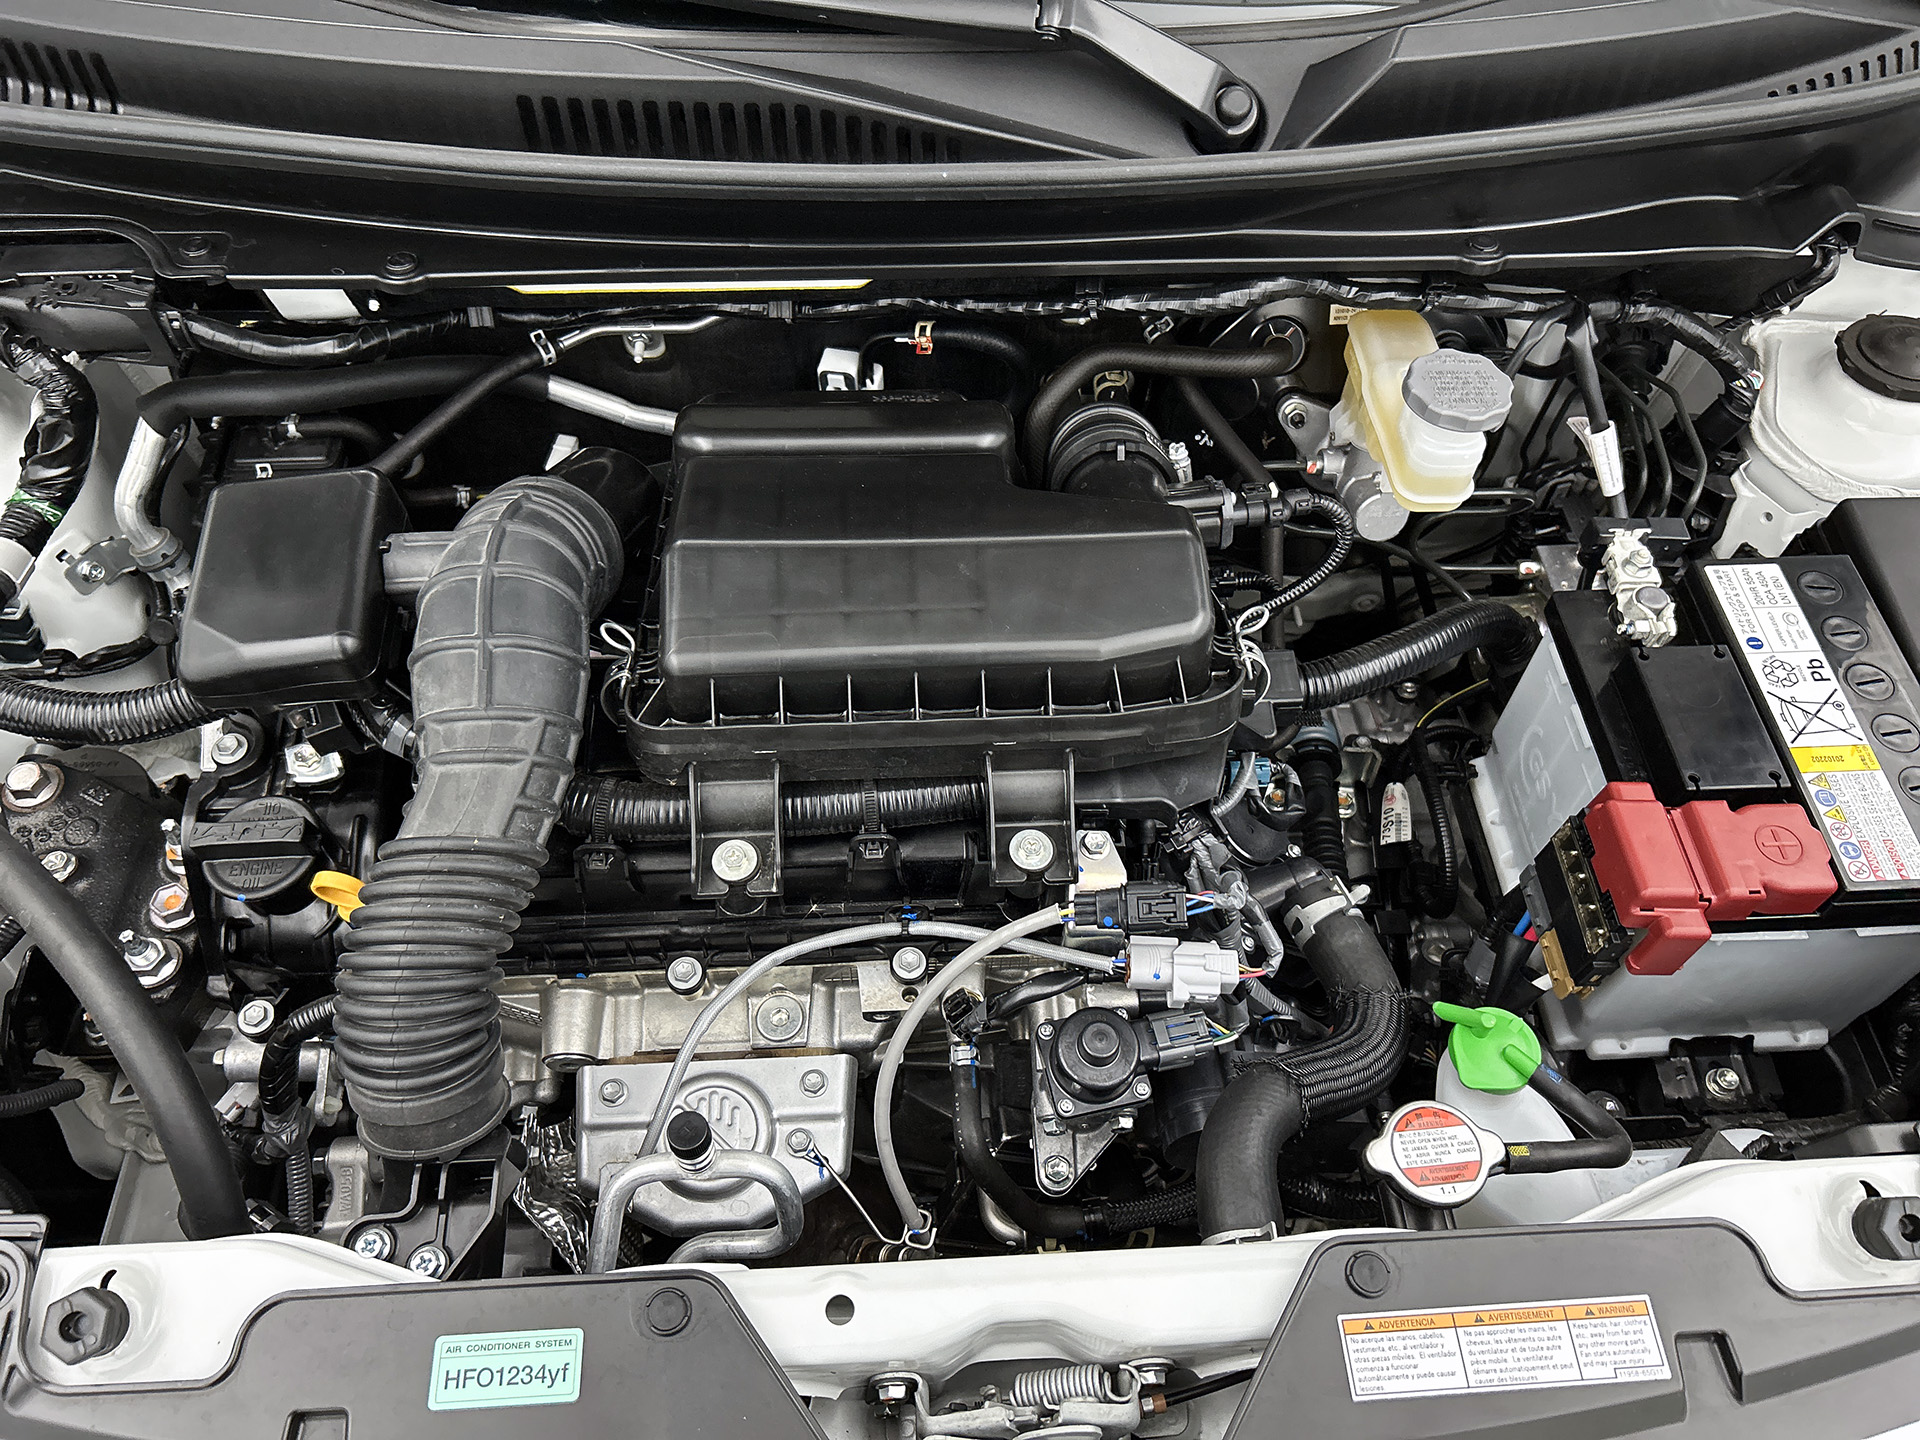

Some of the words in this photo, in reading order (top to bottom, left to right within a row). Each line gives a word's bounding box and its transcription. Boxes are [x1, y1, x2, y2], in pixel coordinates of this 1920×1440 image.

[1722, 569, 1737, 590] START
[1740, 567, 1755, 584] 55Ah
[1770, 575, 1784, 590] (EN)
[1749, 586, 1765, 605] 20HR
[1736, 598, 1750, 616] STOP
[1745, 618, 1757, 632] FOR
[1807, 659, 1831, 682] Pb
[1828, 773, 1846, 797] GASES
[1840, 799, 1866, 838] EXPLOSIVE
[1860, 840, 1881, 869] DANGER
[1884, 839, 1906, 868] POISON
[228, 861, 283, 877] ENGINE
[241, 877, 264, 889] OIL
[1440, 1186, 1457, 1194] 1.1
[1488, 1309, 1555, 1322] AVERTISSEMENT
[1597, 1304, 1635, 1315] WARNING
[1378, 1317, 1435, 1329] ADVERTENCIA
[1486, 1326, 1516, 1336] approcher
[1517, 1325, 1526, 1333] les
[1548, 1323, 1557, 1331] les
[1572, 1322, 1588, 1330] Keep
[1361, 1336, 1384, 1344] acerque
[1386, 1334, 1395, 1342] las
[1410, 1341, 1439, 1350] ventilador
[1504, 1335, 1535, 1344] vêtements
[445, 1345, 462, 1354] AIR
[466, 1341, 530, 1353] CONDITIONER
[535, 1338, 573, 1349] SYSTEM
[1468, 1348, 1476, 1356] du
[1528, 1344, 1544, 1352] toute
[1545, 1343, 1561, 1351] autre
[1427, 1350, 1457, 1358] ventilador
[1391, 1362, 1418, 1370] funcionar
[1583, 1359, 1594, 1367] and
[444, 1362, 570, 1390] HFO1234yf
[1416, 1371, 1435, 1379] puede
[1496, 1375, 1507, 1383] des
